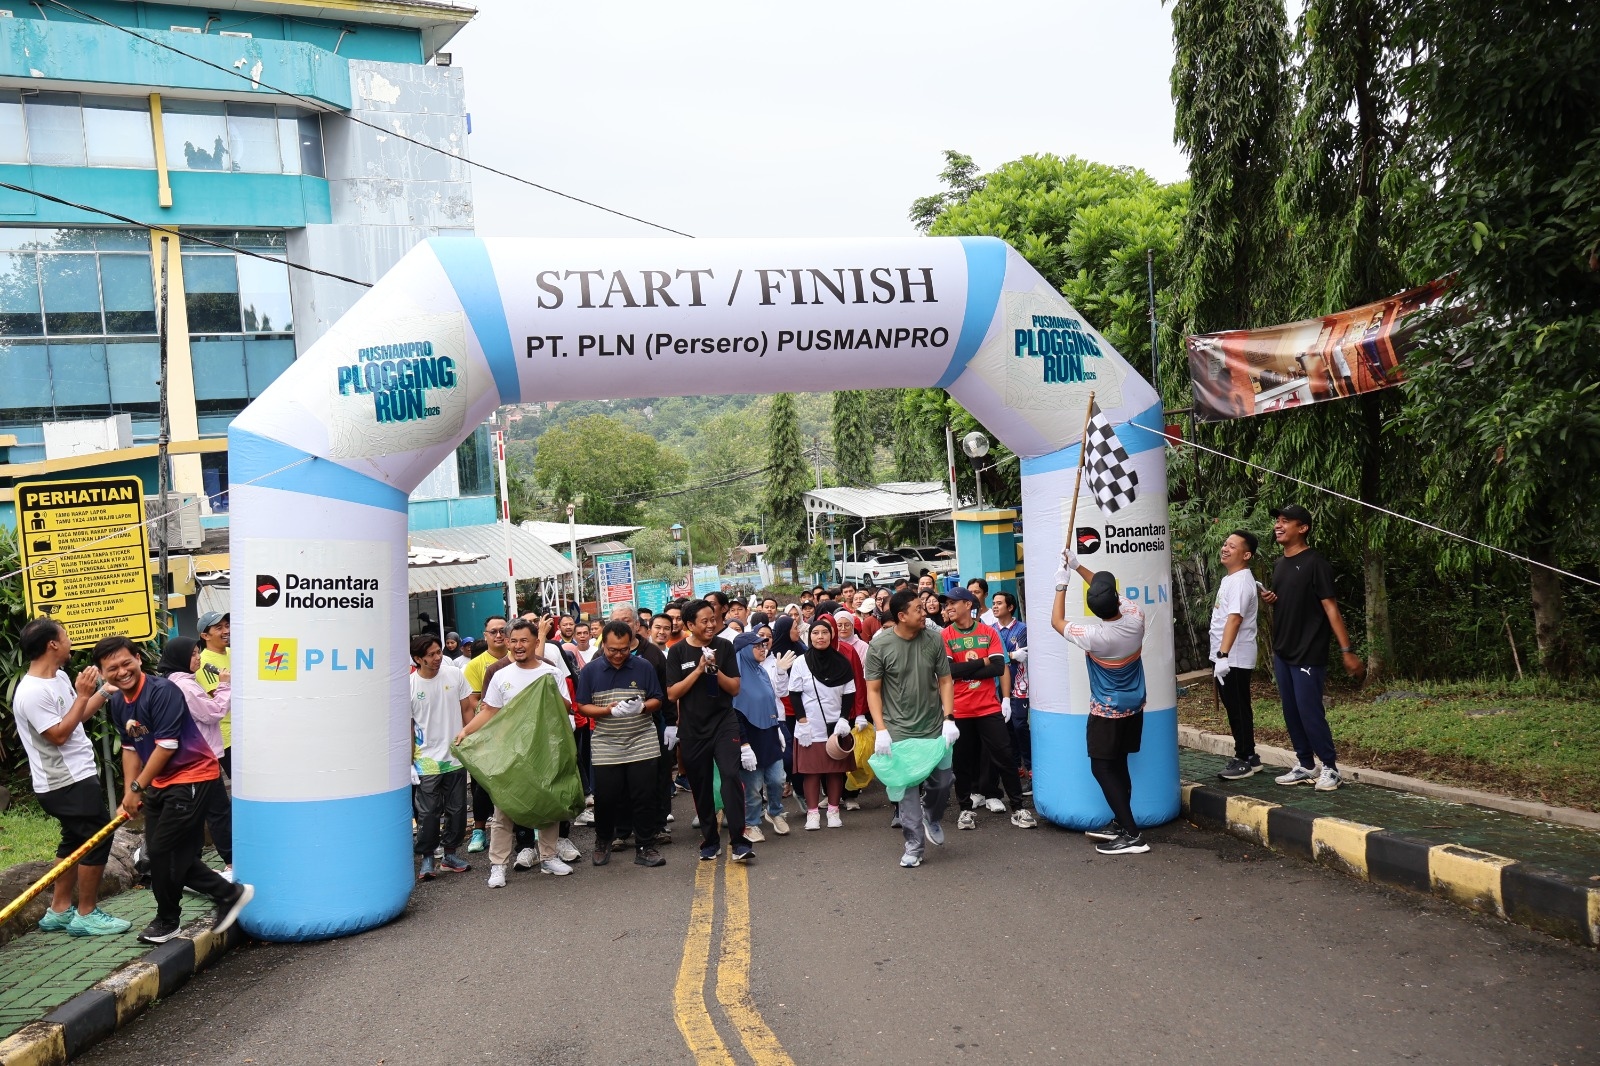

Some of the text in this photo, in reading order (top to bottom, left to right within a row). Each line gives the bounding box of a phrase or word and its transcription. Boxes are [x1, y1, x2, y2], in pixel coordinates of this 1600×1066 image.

[535, 266, 939, 310] START / FINISH
[1032, 314, 1082, 331] PUSMANPRO
[358, 340, 433, 362] PUSMANPRO
[526, 326, 950, 361] PT. PLN (Persero) PUSMANPRO
[1015, 329, 1104, 358] PLOGGING
[337, 356, 457, 396] PLOGGING
[1044, 354, 1097, 384] RUN 2026
[374, 388, 440, 424] RUN 2026
[26, 487, 133, 507] PERHATIAN
[1105, 523, 1166, 538] Danantara
[1106, 538, 1165, 554] Indonesia
[286, 574, 379, 590] Danantara
[286, 593, 374, 608] Indonesia
[1126, 584, 1168, 604] PLN
[305, 648, 374, 671] PLN
